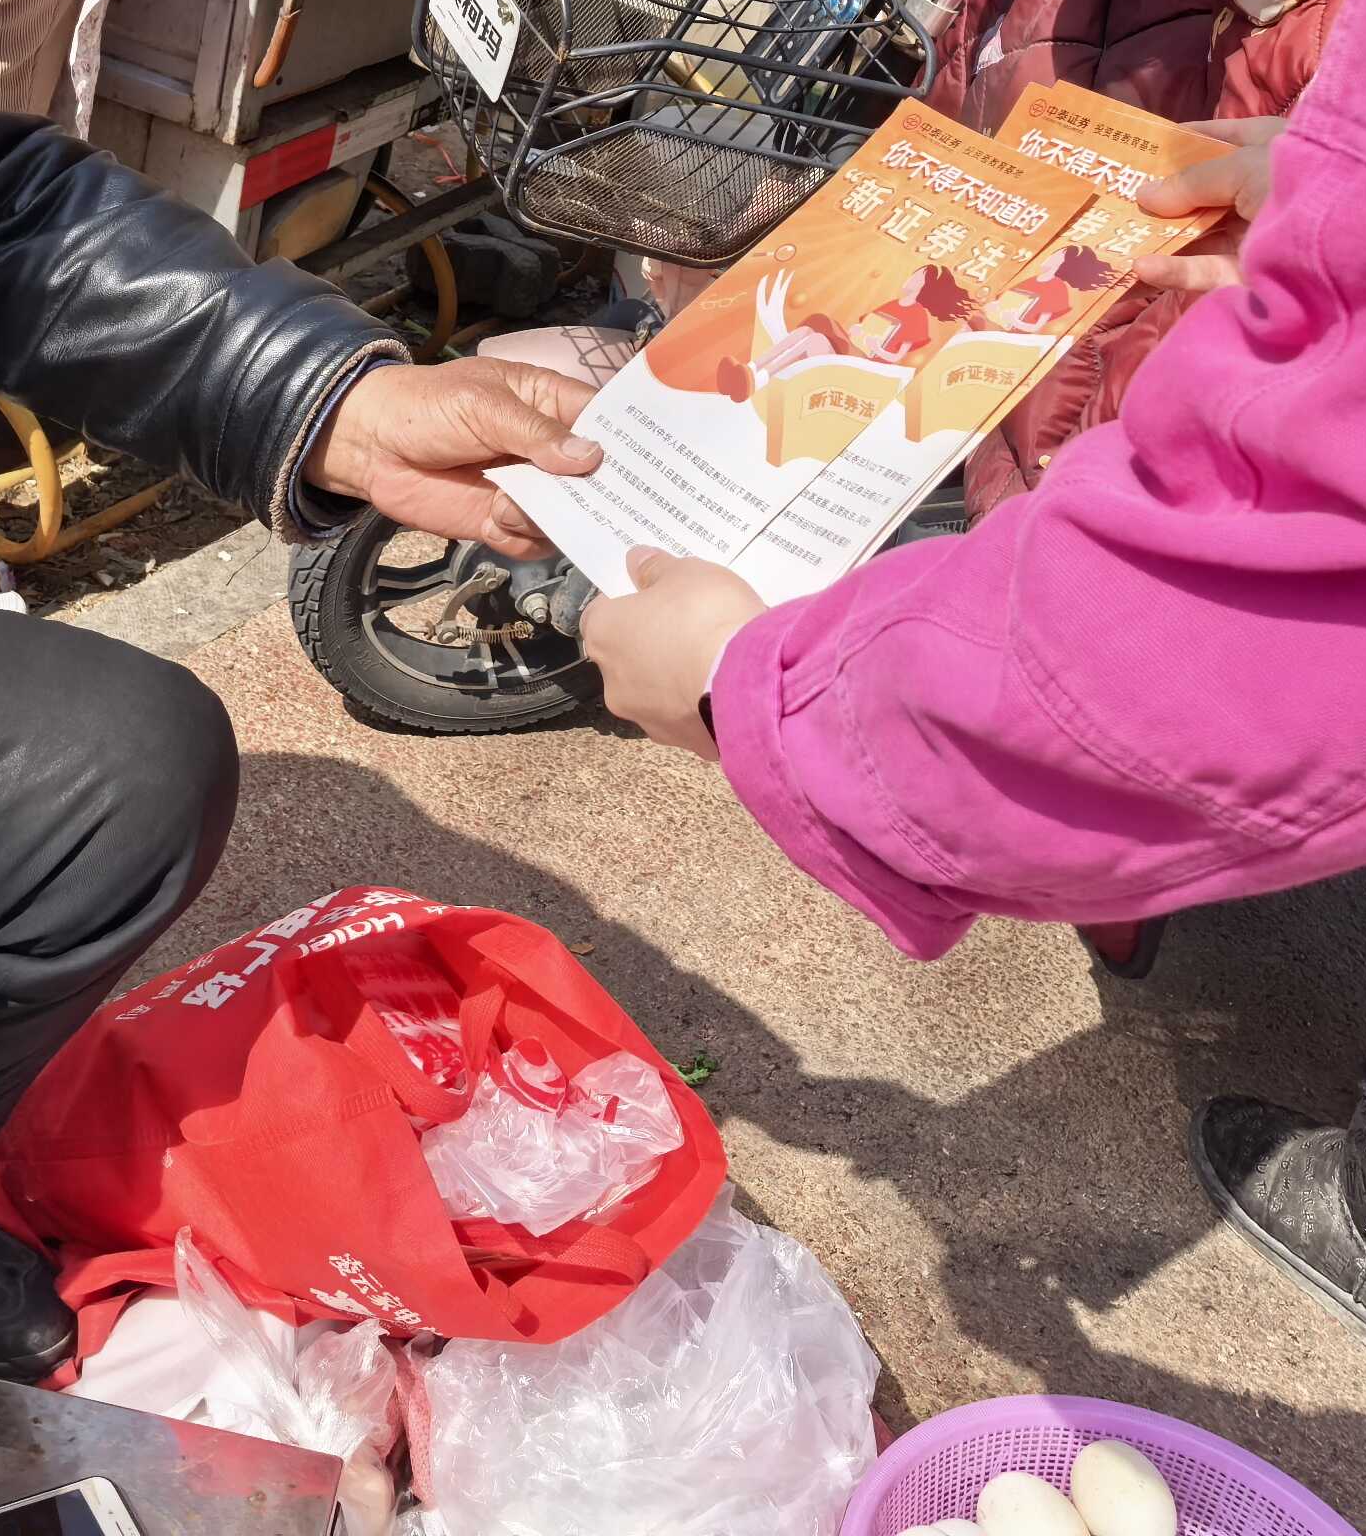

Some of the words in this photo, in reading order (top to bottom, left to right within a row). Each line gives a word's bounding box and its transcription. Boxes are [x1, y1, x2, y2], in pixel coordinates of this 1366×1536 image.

[920, 121, 962, 151] 中泰证券
[1046, 104, 1091, 131] 中泰证券
[1017, 127, 1165, 202] 你不得不知
[880, 139, 1051, 237] 你不得不知道的
[807, 390, 876, 419] 新证券法
[299, 911, 406, 958] Haier
